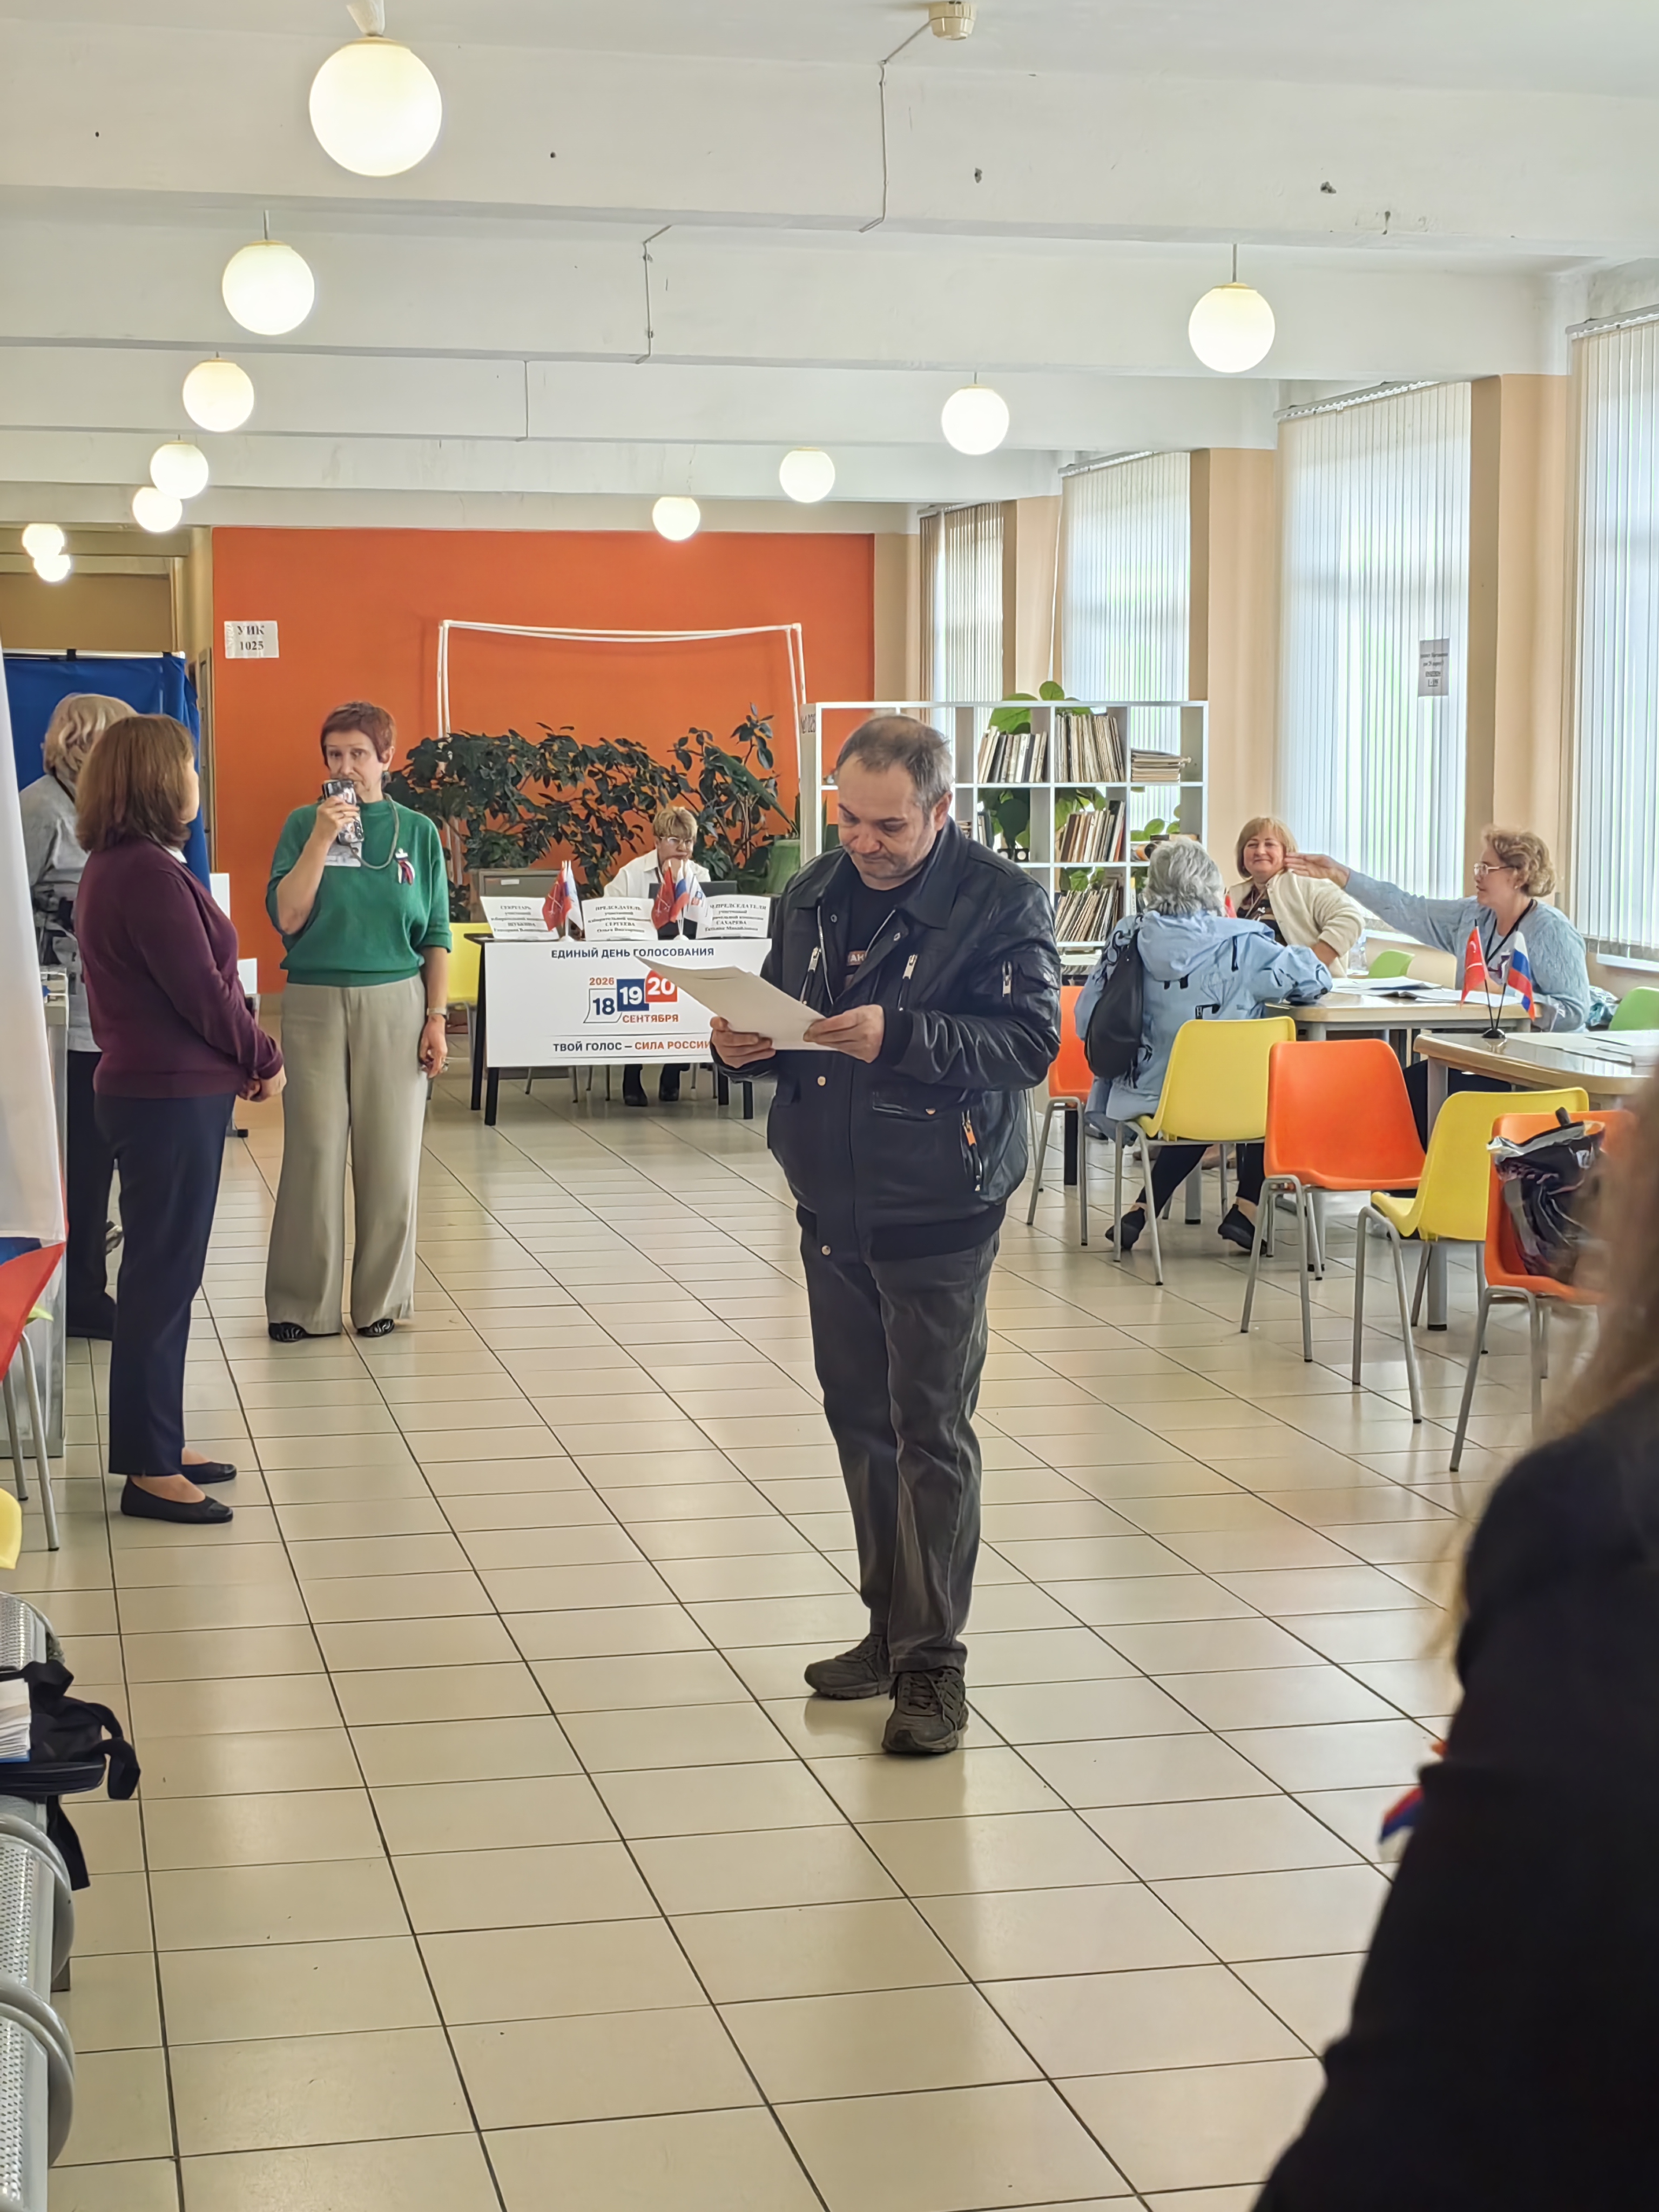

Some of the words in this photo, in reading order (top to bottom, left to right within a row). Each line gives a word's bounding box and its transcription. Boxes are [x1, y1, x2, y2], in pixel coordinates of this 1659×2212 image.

[237, 625, 265, 635] УИК
[240, 641, 264, 650] 1025
[551, 948, 598, 959] ЕДИНЫЙ
[601, 949, 630, 959] ДЕНЬ
[633, 948, 714, 957] ГОЛОСОВАНИЯ
[589, 977, 615, 986] 2026
[592, 997, 615, 1016] 18
[619, 986, 643, 1005] 19
[648, 977, 675, 995] 20
[622, 1014, 679, 1023] СЕНТЯБРЯ
[553, 1041, 583, 1052] ТВОЙ
[586, 1042, 622, 1051] ГОЛОС
[635, 1041, 664, 1050] СИЛА
